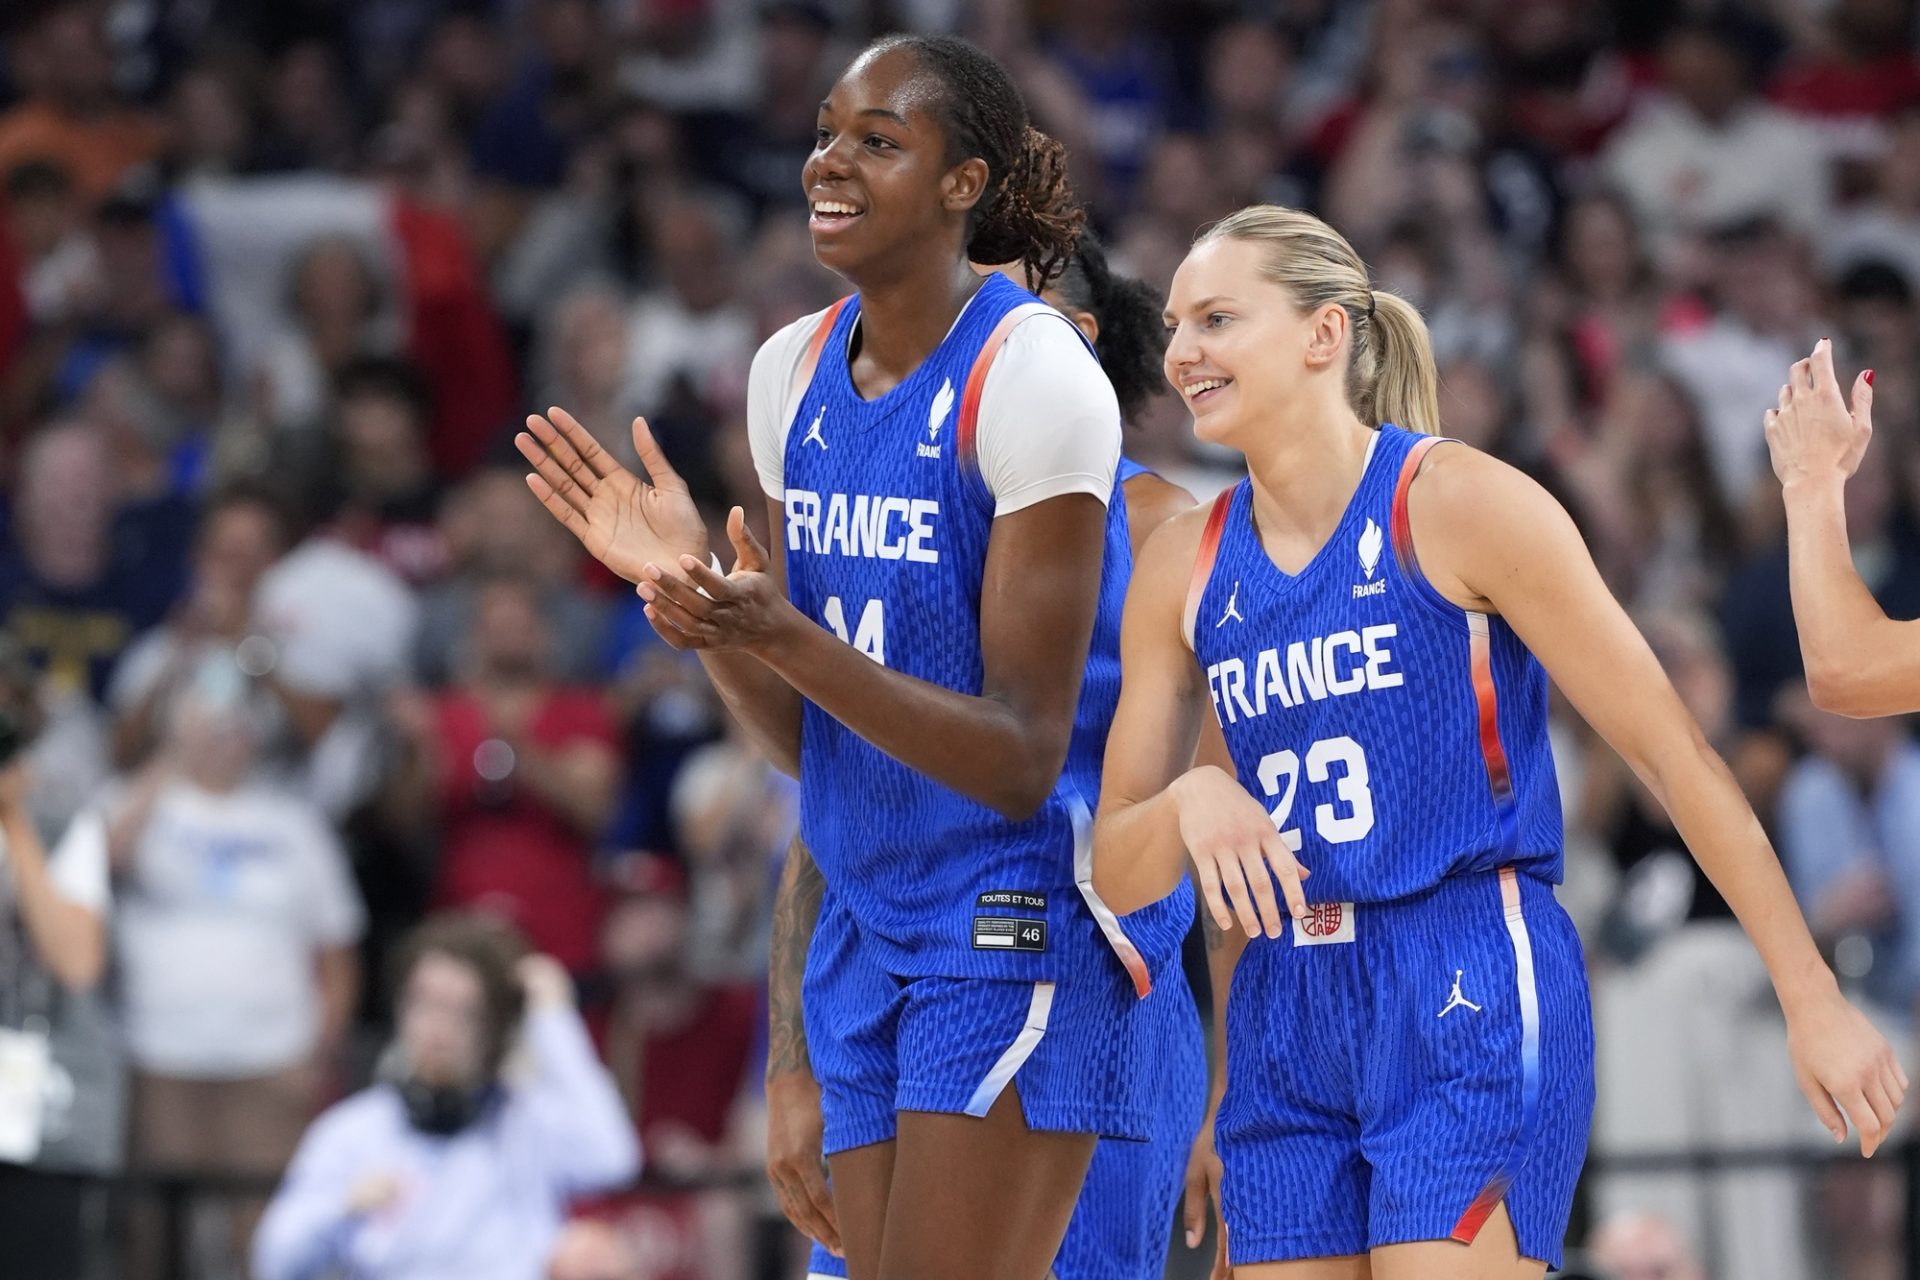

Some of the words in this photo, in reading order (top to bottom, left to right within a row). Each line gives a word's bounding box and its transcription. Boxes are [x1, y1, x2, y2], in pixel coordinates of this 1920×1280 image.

[785, 489, 939, 564] FRANCE
[1353, 578, 1386, 599] FRANCE
[1207, 623, 1404, 728] FRANCE
[1257, 736, 1375, 852] 23
[981, 894, 1010, 903] TOUTES
[1012, 895, 1022, 903] ET
[1024, 896, 1045, 907] TOUS
[1021, 928, 1040, 941] 46
